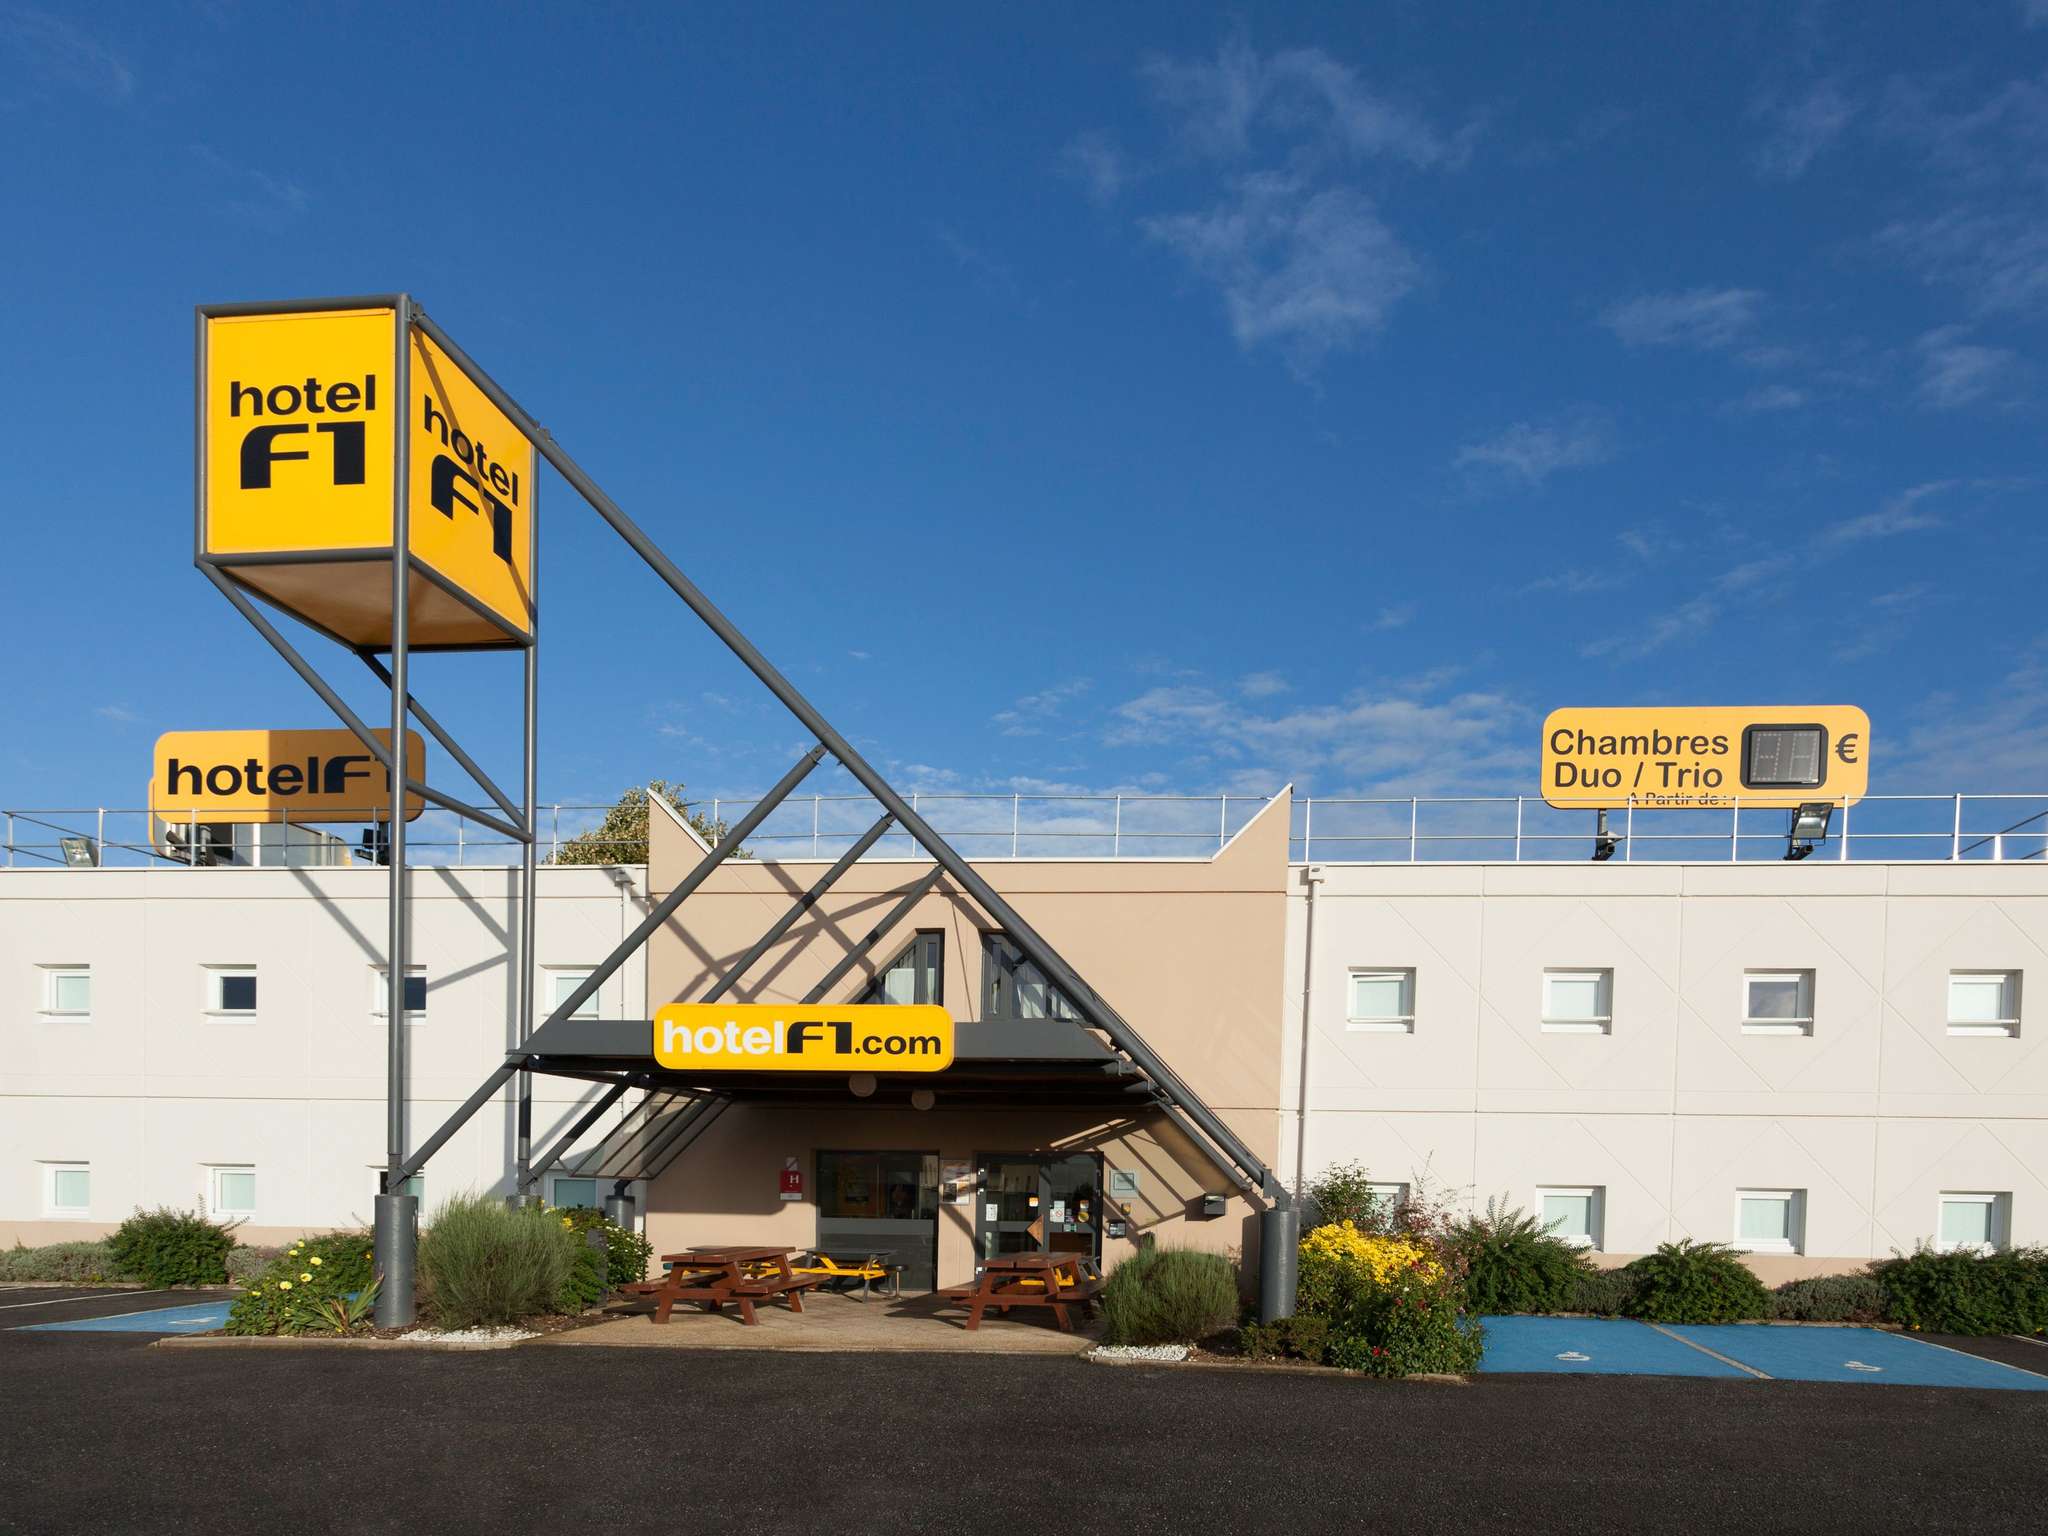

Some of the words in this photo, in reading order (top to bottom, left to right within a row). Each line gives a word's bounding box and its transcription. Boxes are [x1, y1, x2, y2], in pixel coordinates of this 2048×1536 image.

[230, 374, 377, 418] hotel
[240, 421, 366, 490] F1
[423, 395, 519, 507] hotel
[431, 453, 513, 567] F1
[1550, 728, 1729, 756] Chambres
[1835, 733, 1859, 764] €
[167, 755, 407, 796] hotelF
[1554, 762, 1622, 788] Duo
[1633, 762, 1644, 788] /
[1655, 761, 1723, 788] Trio
[1646, 792, 1693, 806] Partir
[663, 1019, 942, 1055] hotelF1.com
